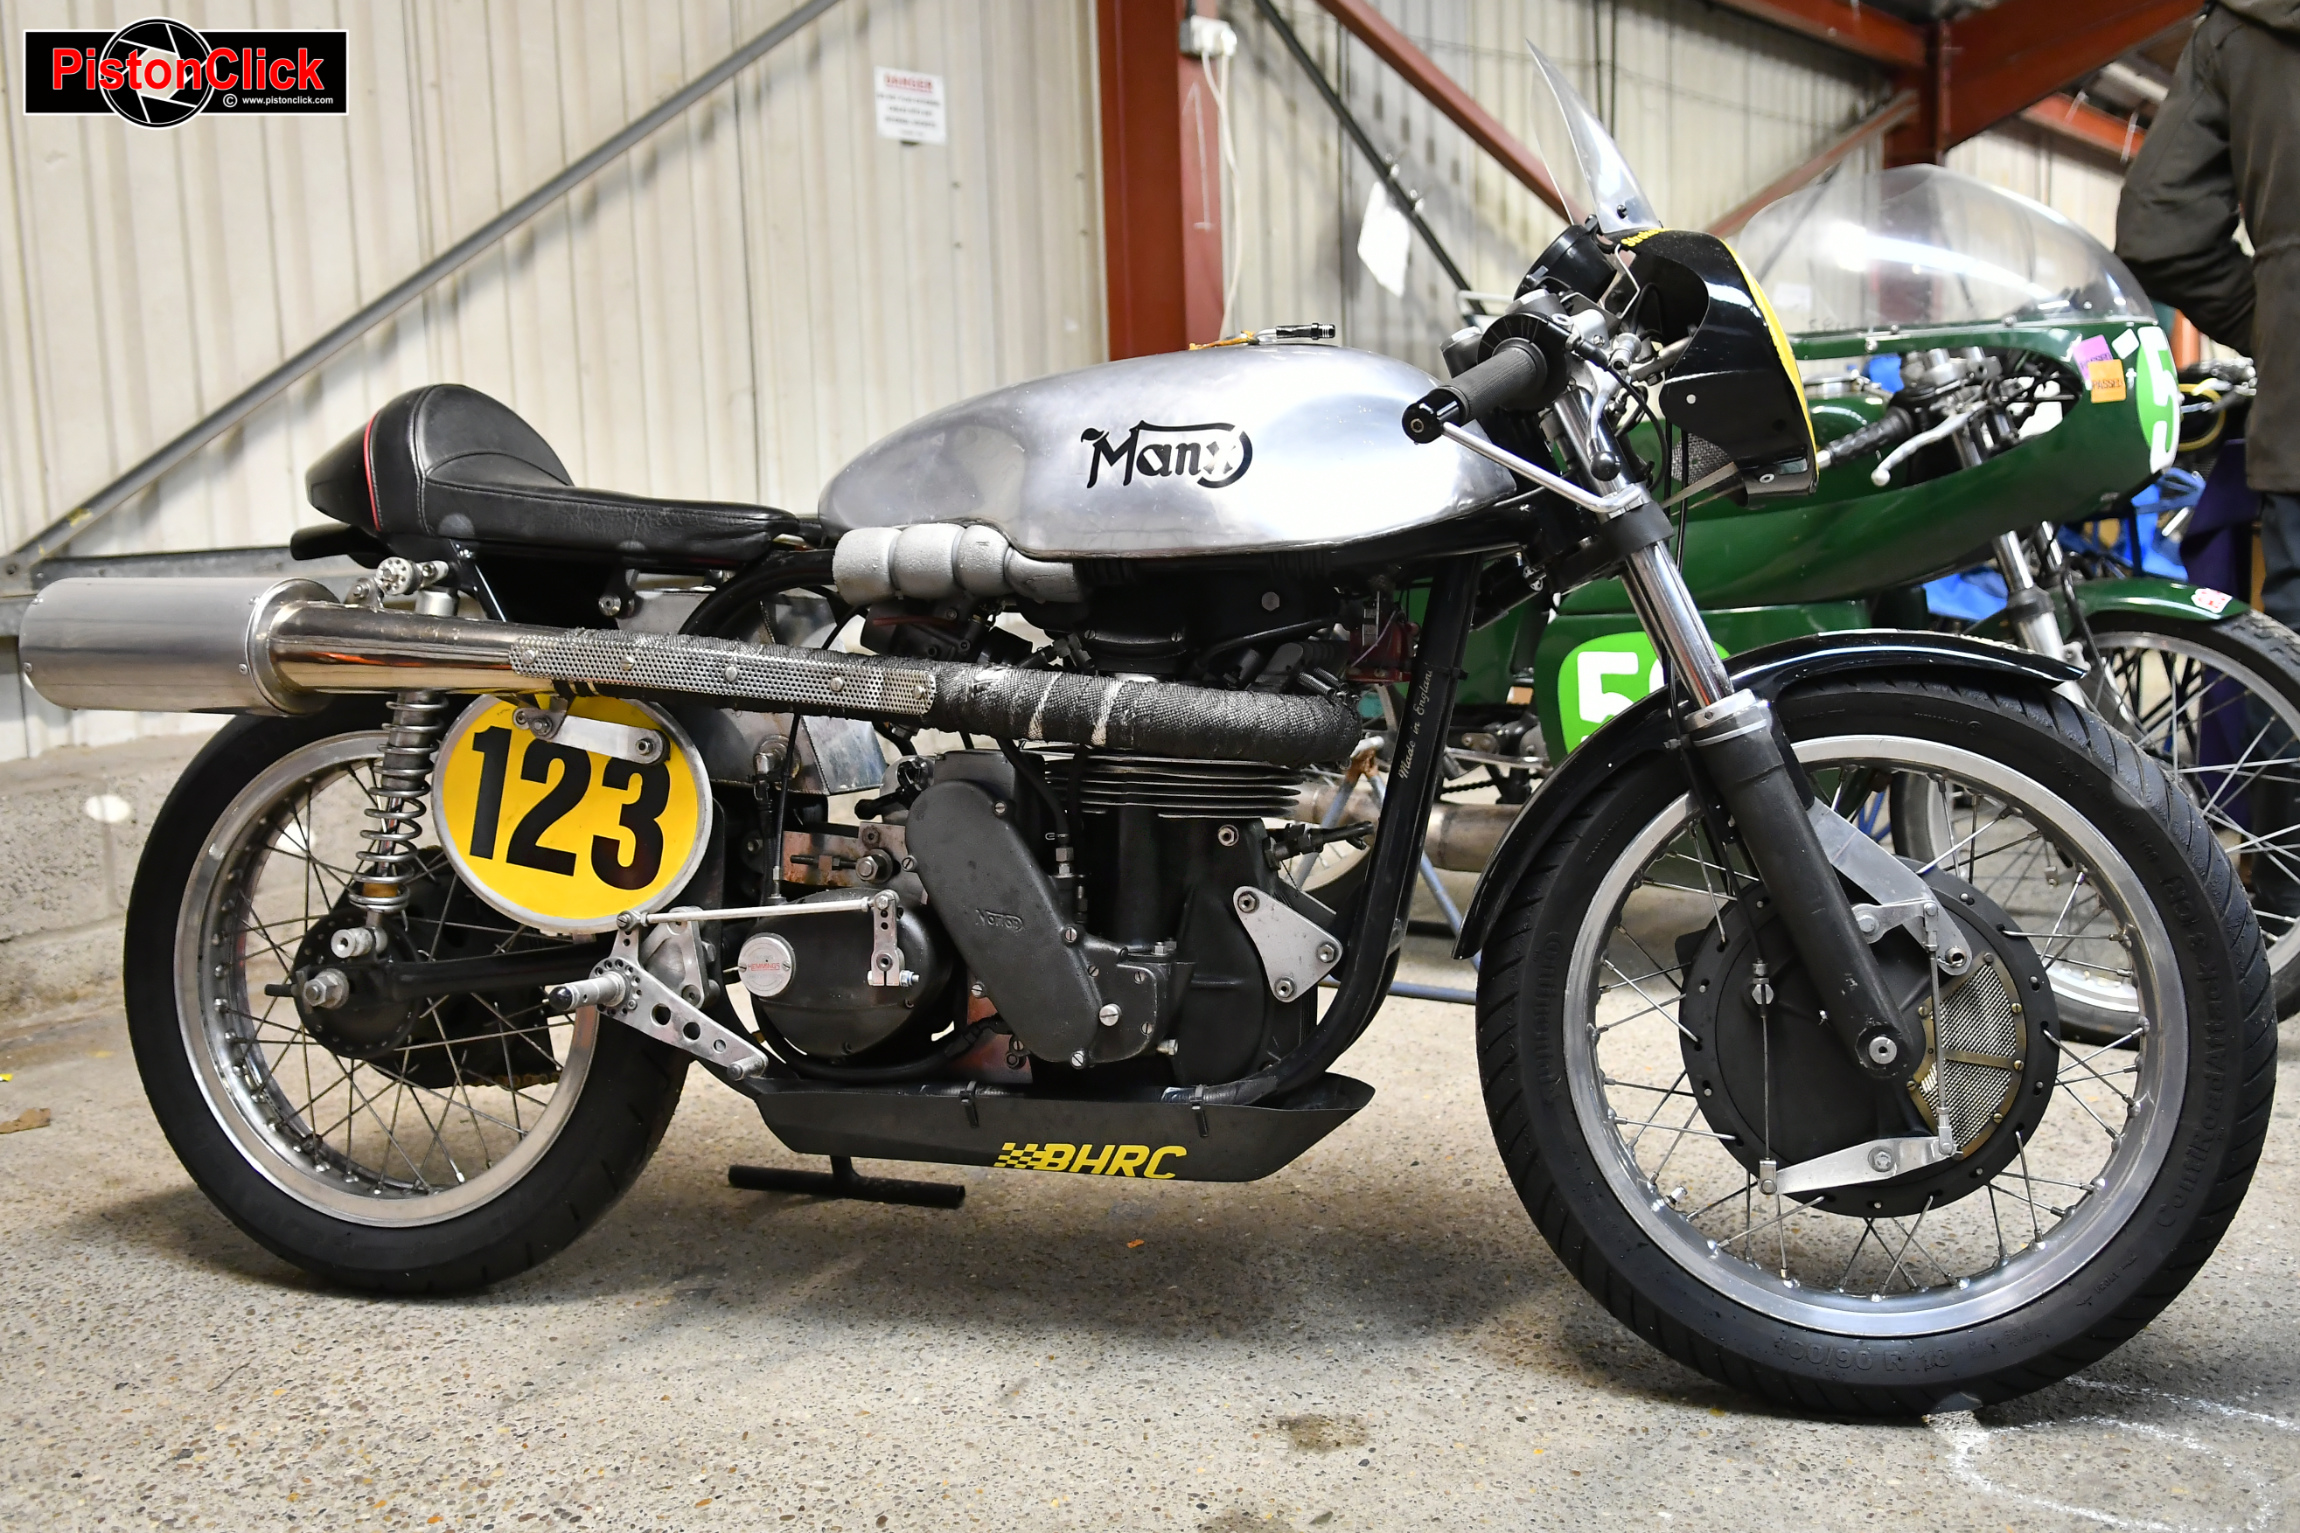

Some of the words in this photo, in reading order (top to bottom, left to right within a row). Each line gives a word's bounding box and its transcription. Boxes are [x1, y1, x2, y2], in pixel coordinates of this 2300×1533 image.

[1399, 740, 1417, 779] Made
[1410, 721, 1421, 735] in
[469, 725, 671, 890] 123
[1033, 1143, 1188, 1180] BHRC
